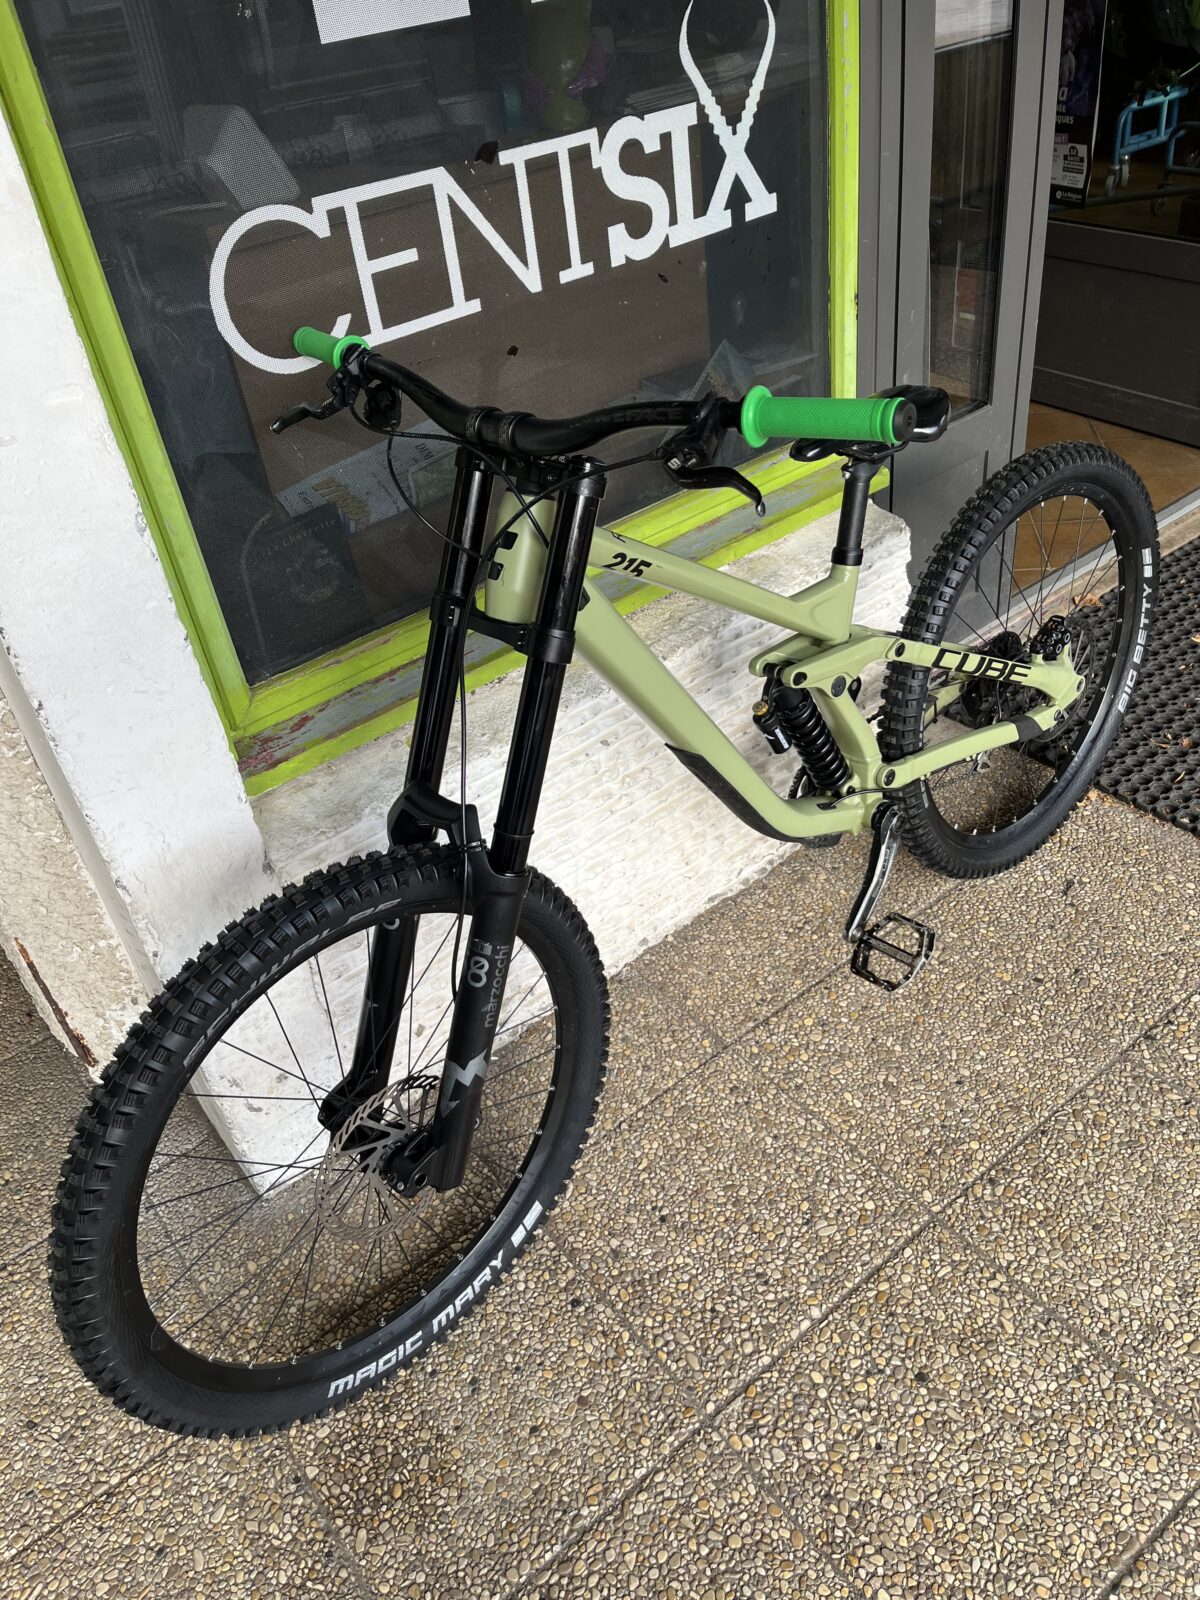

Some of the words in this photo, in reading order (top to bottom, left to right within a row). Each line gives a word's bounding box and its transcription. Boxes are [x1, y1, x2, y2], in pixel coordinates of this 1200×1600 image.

[602, 552, 653, 577] 215
[931, 647, 1032, 684] CUBE
[1117, 666, 1138, 714] BIG
[1132, 586, 1153, 662] BETTY
[481, 944, 510, 1028] marzocchi
[328, 1329, 424, 1399] MAGIC
[432, 1247, 506, 1337] MARY
